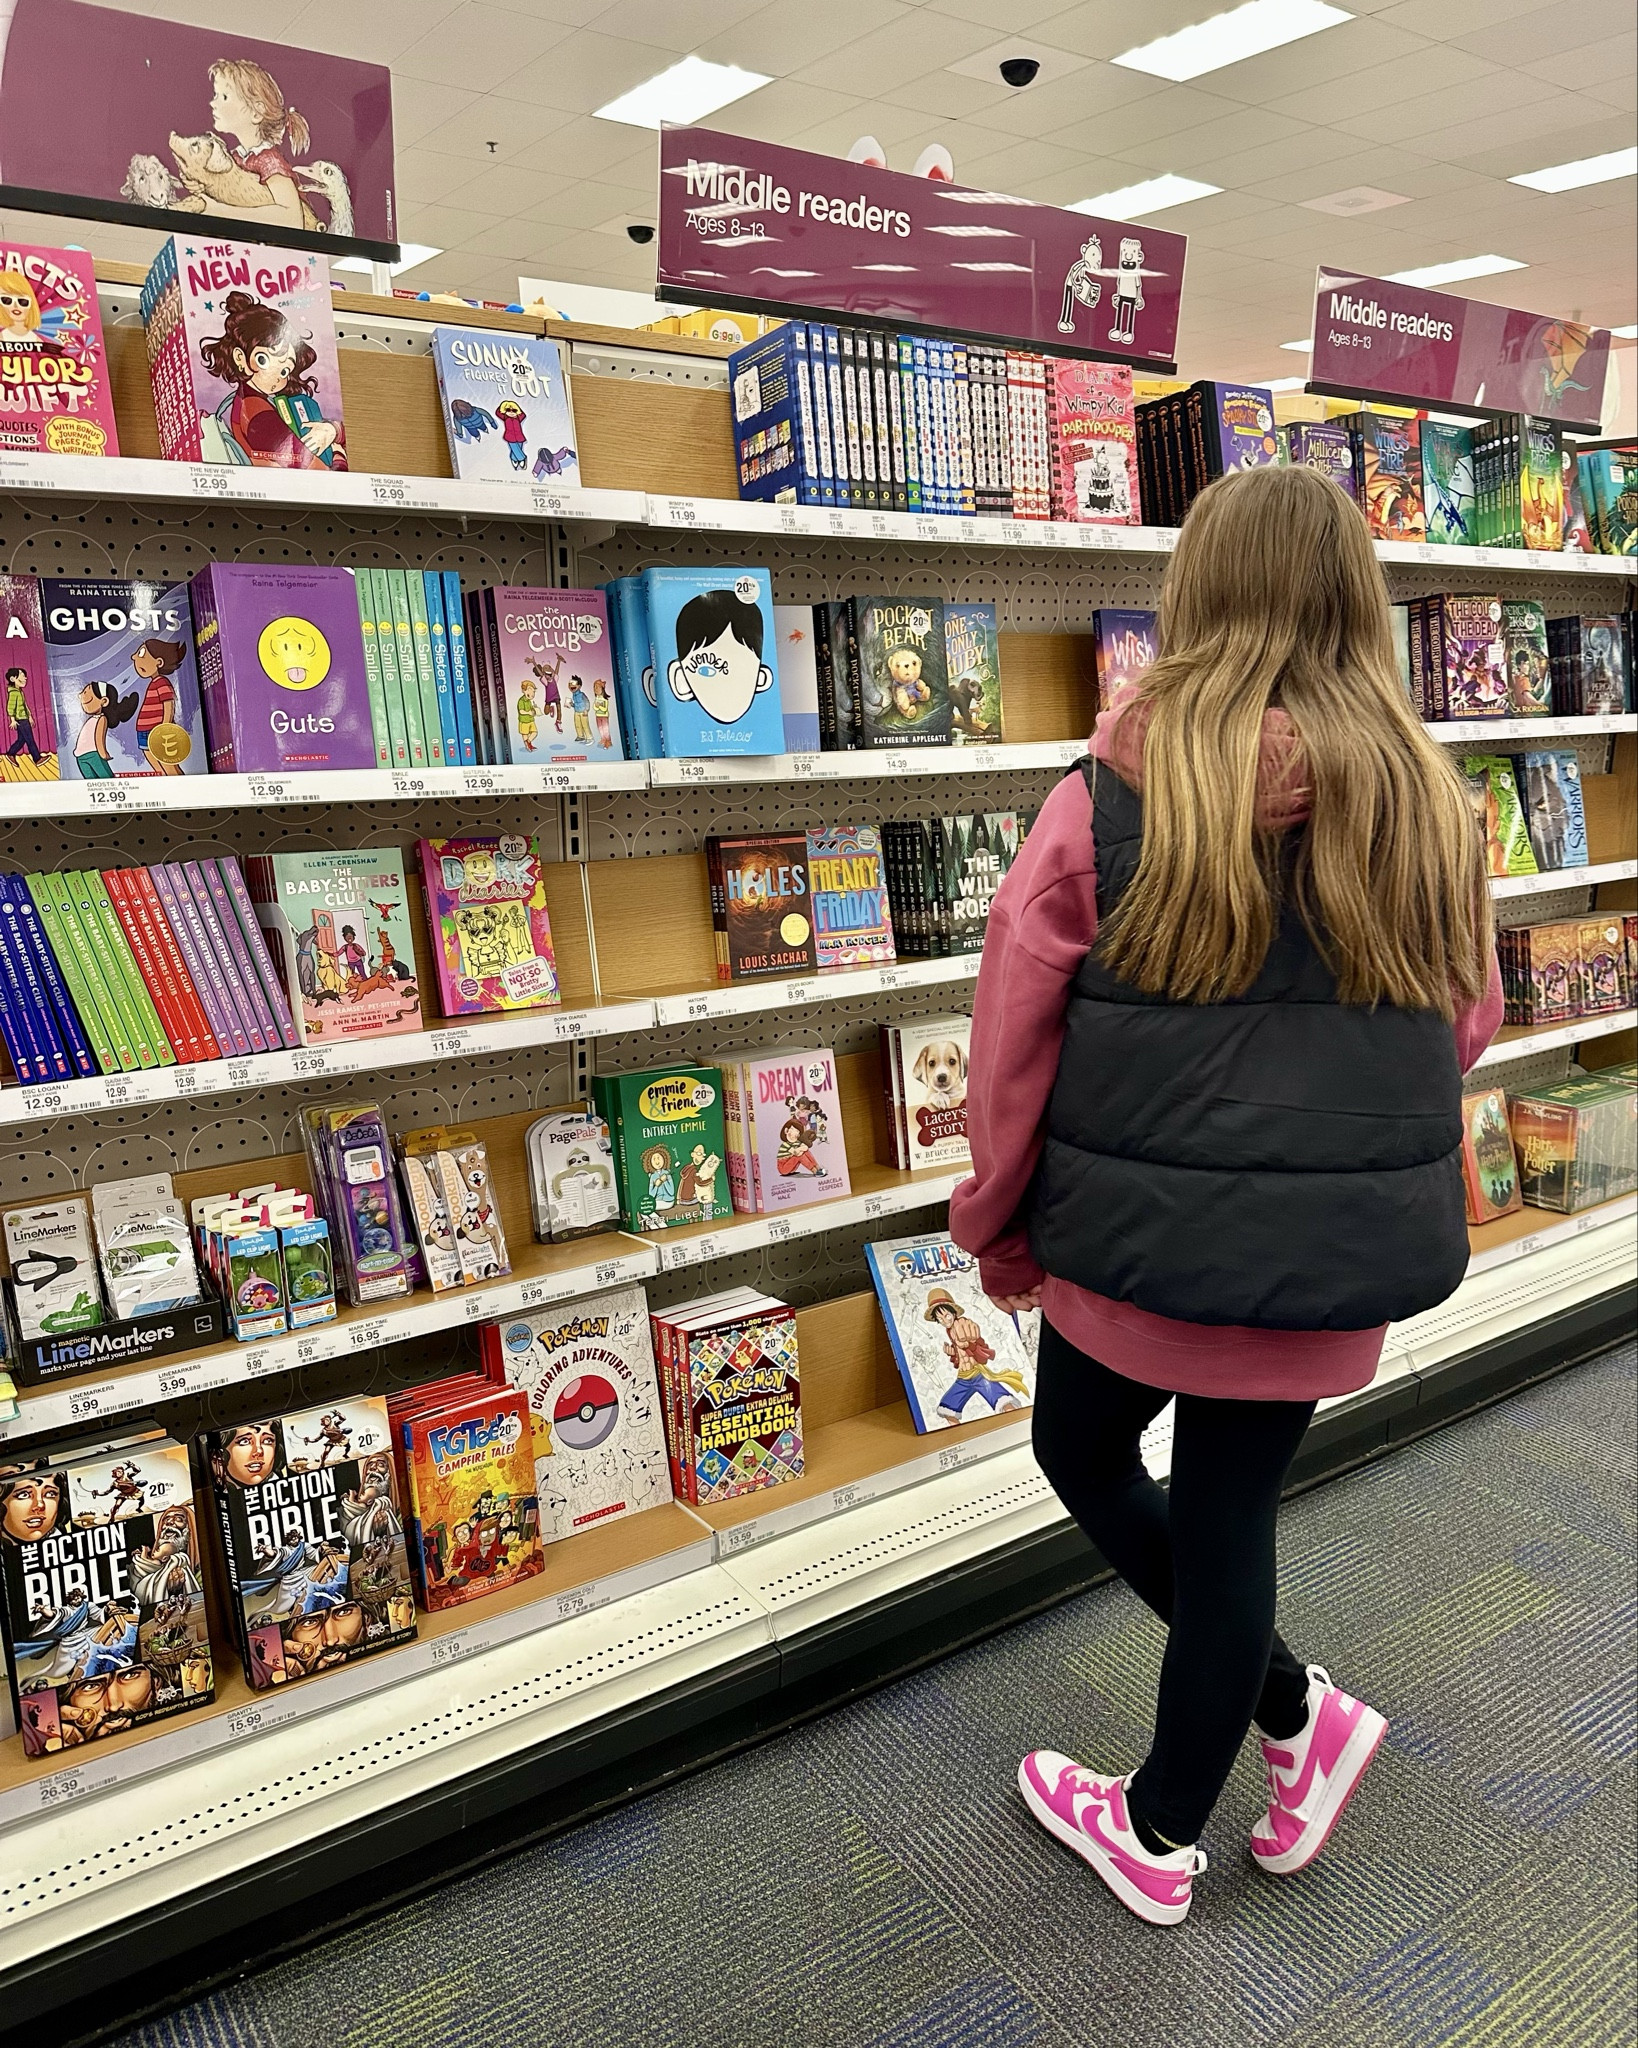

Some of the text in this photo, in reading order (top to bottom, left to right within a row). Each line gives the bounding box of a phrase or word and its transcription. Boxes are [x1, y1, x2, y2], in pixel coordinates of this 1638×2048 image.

[686, 158, 911, 238] Middle readers
[685, 213, 726, 236] Ages
[204, 244, 235, 258] THE
[187, 258, 323, 298] NEW GIRL
[1330, 292, 1453, 342] Middle readers
[1328, 329, 1351, 347] Ages
[451, 340, 530, 370] SUNNY
[464, 368, 507, 383] FIGURES
[497, 383, 507, 395] IT
[1064, 396, 1125, 417] Wimpy Kid
[53, 423, 76, 431] WITH
[55, 438, 99, 450] PAGES FOR
[1373, 429, 1411, 451] WINGS
[1527, 430, 1555, 451] WINGS
[1379, 449, 1405, 469] FIRE
[192, 477, 228, 490] 12.99
[373, 488, 404, 499] 12.99
[533, 498, 561, 509] 12.99
[670, 510, 695, 521] 11.99
[917, 526, 938, 535] 11.99
[1003, 530, 1023, 539] 11.99
[252, 579, 318, 589] Raina Telgemeier
[70, 589, 100, 597] RAINA
[543, 606, 560, 614] the
[1450, 602, 1470, 617] THE
[50, 607, 182, 632] GHOSTS
[1454, 620, 1498, 636] THE DEAD
[528, 631, 581, 653] CLUB
[882, 626, 927, 650] BEAR
[365, 643, 380, 682] Smile
[382, 643, 397, 682] Smile
[418, 643, 432, 681] Smile
[434, 643, 447, 694] Sisters
[453, 643, 465, 694] Sisters
[1435, 684, 1444, 711] DEAD
[270, 710, 335, 734] Guts
[874, 735, 947, 744] KATHERINE APPLEGATE
[976, 755, 994, 765] 10.99
[1060, 752, 1078, 761] 10.99
[680, 766, 704, 776] 14.39
[794, 764, 811, 772] 9.99
[887, 760, 907, 768] 14.39
[394, 780, 424, 791] 12.99
[465, 778, 493, 788] 12.99
[542, 776, 570, 785] 11.99
[89, 791, 126, 803] 12.99
[250, 785, 284, 796] 12.99
[337, 858, 378, 866] CRENSHAW
[963, 854, 1000, 874] THE
[333, 868, 352, 876] THE
[441, 851, 535, 890] DORK
[808, 856, 879, 892] FREAKY
[285, 873, 400, 896] BABY-SITTERS
[727, 864, 806, 900] HOLES
[324, 892, 367, 906] CLUB
[459, 882, 530, 902] diaries
[815, 890, 883, 932] FRIDAY
[846, 935, 888, 947] RODGERS
[739, 955, 768, 969] LOUIS
[771, 950, 808, 965] SACHAR
[964, 963, 979, 973] 9.99
[520, 978, 539, 988] Bratty
[880, 975, 897, 985] 9.99
[788, 989, 805, 999] 8.99
[317, 1007, 335, 1016] JESSI
[689, 1004, 708, 1015] 8.99
[332, 1019, 350, 1027] ANN
[361, 1013, 390, 1023] MARTIN
[555, 1022, 581, 1034] 11.99
[433, 1039, 461, 1052] 11.99
[293, 1058, 325, 1071] 12.99
[228, 1068, 248, 1080] 10.39
[37, 1085, 62, 1093] LOGAN
[175, 1076, 196, 1088] 12.99
[758, 1065, 806, 1104] DREAM
[105, 1086, 127, 1098] 12.99
[648, 1081, 686, 1100] emmie
[24, 1096, 61, 1110] 12.99
[549, 1126, 597, 1144] PagePals
[642, 1120, 706, 1139] ENTIRELY EMMIE
[1527, 1135, 1557, 1156] Harry
[1524, 1150, 1556, 1175] Potter
[817, 1177, 843, 1186] MARCELA
[818, 1182, 844, 1192] CESPEDES
[771, 1187, 797, 1197] SHANNON
[675, 1206, 729, 1222] LIBENSON
[865, 1204, 881, 1214] 9.99
[13, 1223, 77, 1242] LineMarkers
[769, 1226, 790, 1238] 11.99
[700, 1245, 714, 1254] 12.79
[672, 1252, 686, 1262] 12.79
[370, 1271, 398, 1281] WARNING
[596, 1271, 616, 1282] 5.99
[920, 1276, 943, 1285] COLORING
[522, 1288, 543, 1300] 9.99
[742, 1317, 762, 1327] 1,000
[58, 1334, 90, 1347] magnetic
[350, 1330, 380, 1343] 16.95
[536, 1316, 610, 1354] Pokémon
[37, 1325, 175, 1368] LineMarkers
[40, 1345, 153, 1376] marks your page and your last line
[158, 1364, 201, 1379] LINEMARKERS
[532, 1347, 633, 1410] COLORING ADVENTURES
[160, 1377, 186, 1392] 3.99
[705, 1367, 787, 1407] Pokémon
[69, 1384, 115, 1400] LINEMARKERS
[71, 1399, 98, 1414] 3.99
[701, 1392, 794, 1423] SUPER EXTRA DELUXE
[700, 1402, 795, 1437] ESSENTIAL
[701, 1415, 796, 1452] HANDBOOK
[437, 1449, 486, 1476] CAMPFIRE
[491, 1443, 516, 1459] TALES
[939, 1455, 959, 1466] 12.79
[262, 1471, 336, 1511] ACTION
[834, 1493, 854, 1505] 16.00
[248, 1495, 341, 1560] BIBLE
[42, 1522, 127, 1568] ACTION
[729, 1531, 752, 1545] 13.59
[24, 1551, 131, 1622] BIBLE
[557, 1598, 583, 1613] 12.79
[349, 1646, 365, 1656] GOD'S
[431, 1643, 460, 1660] 15.19
[229, 1713, 262, 1732] 15.99
[40, 1780, 78, 1800] 26.39
